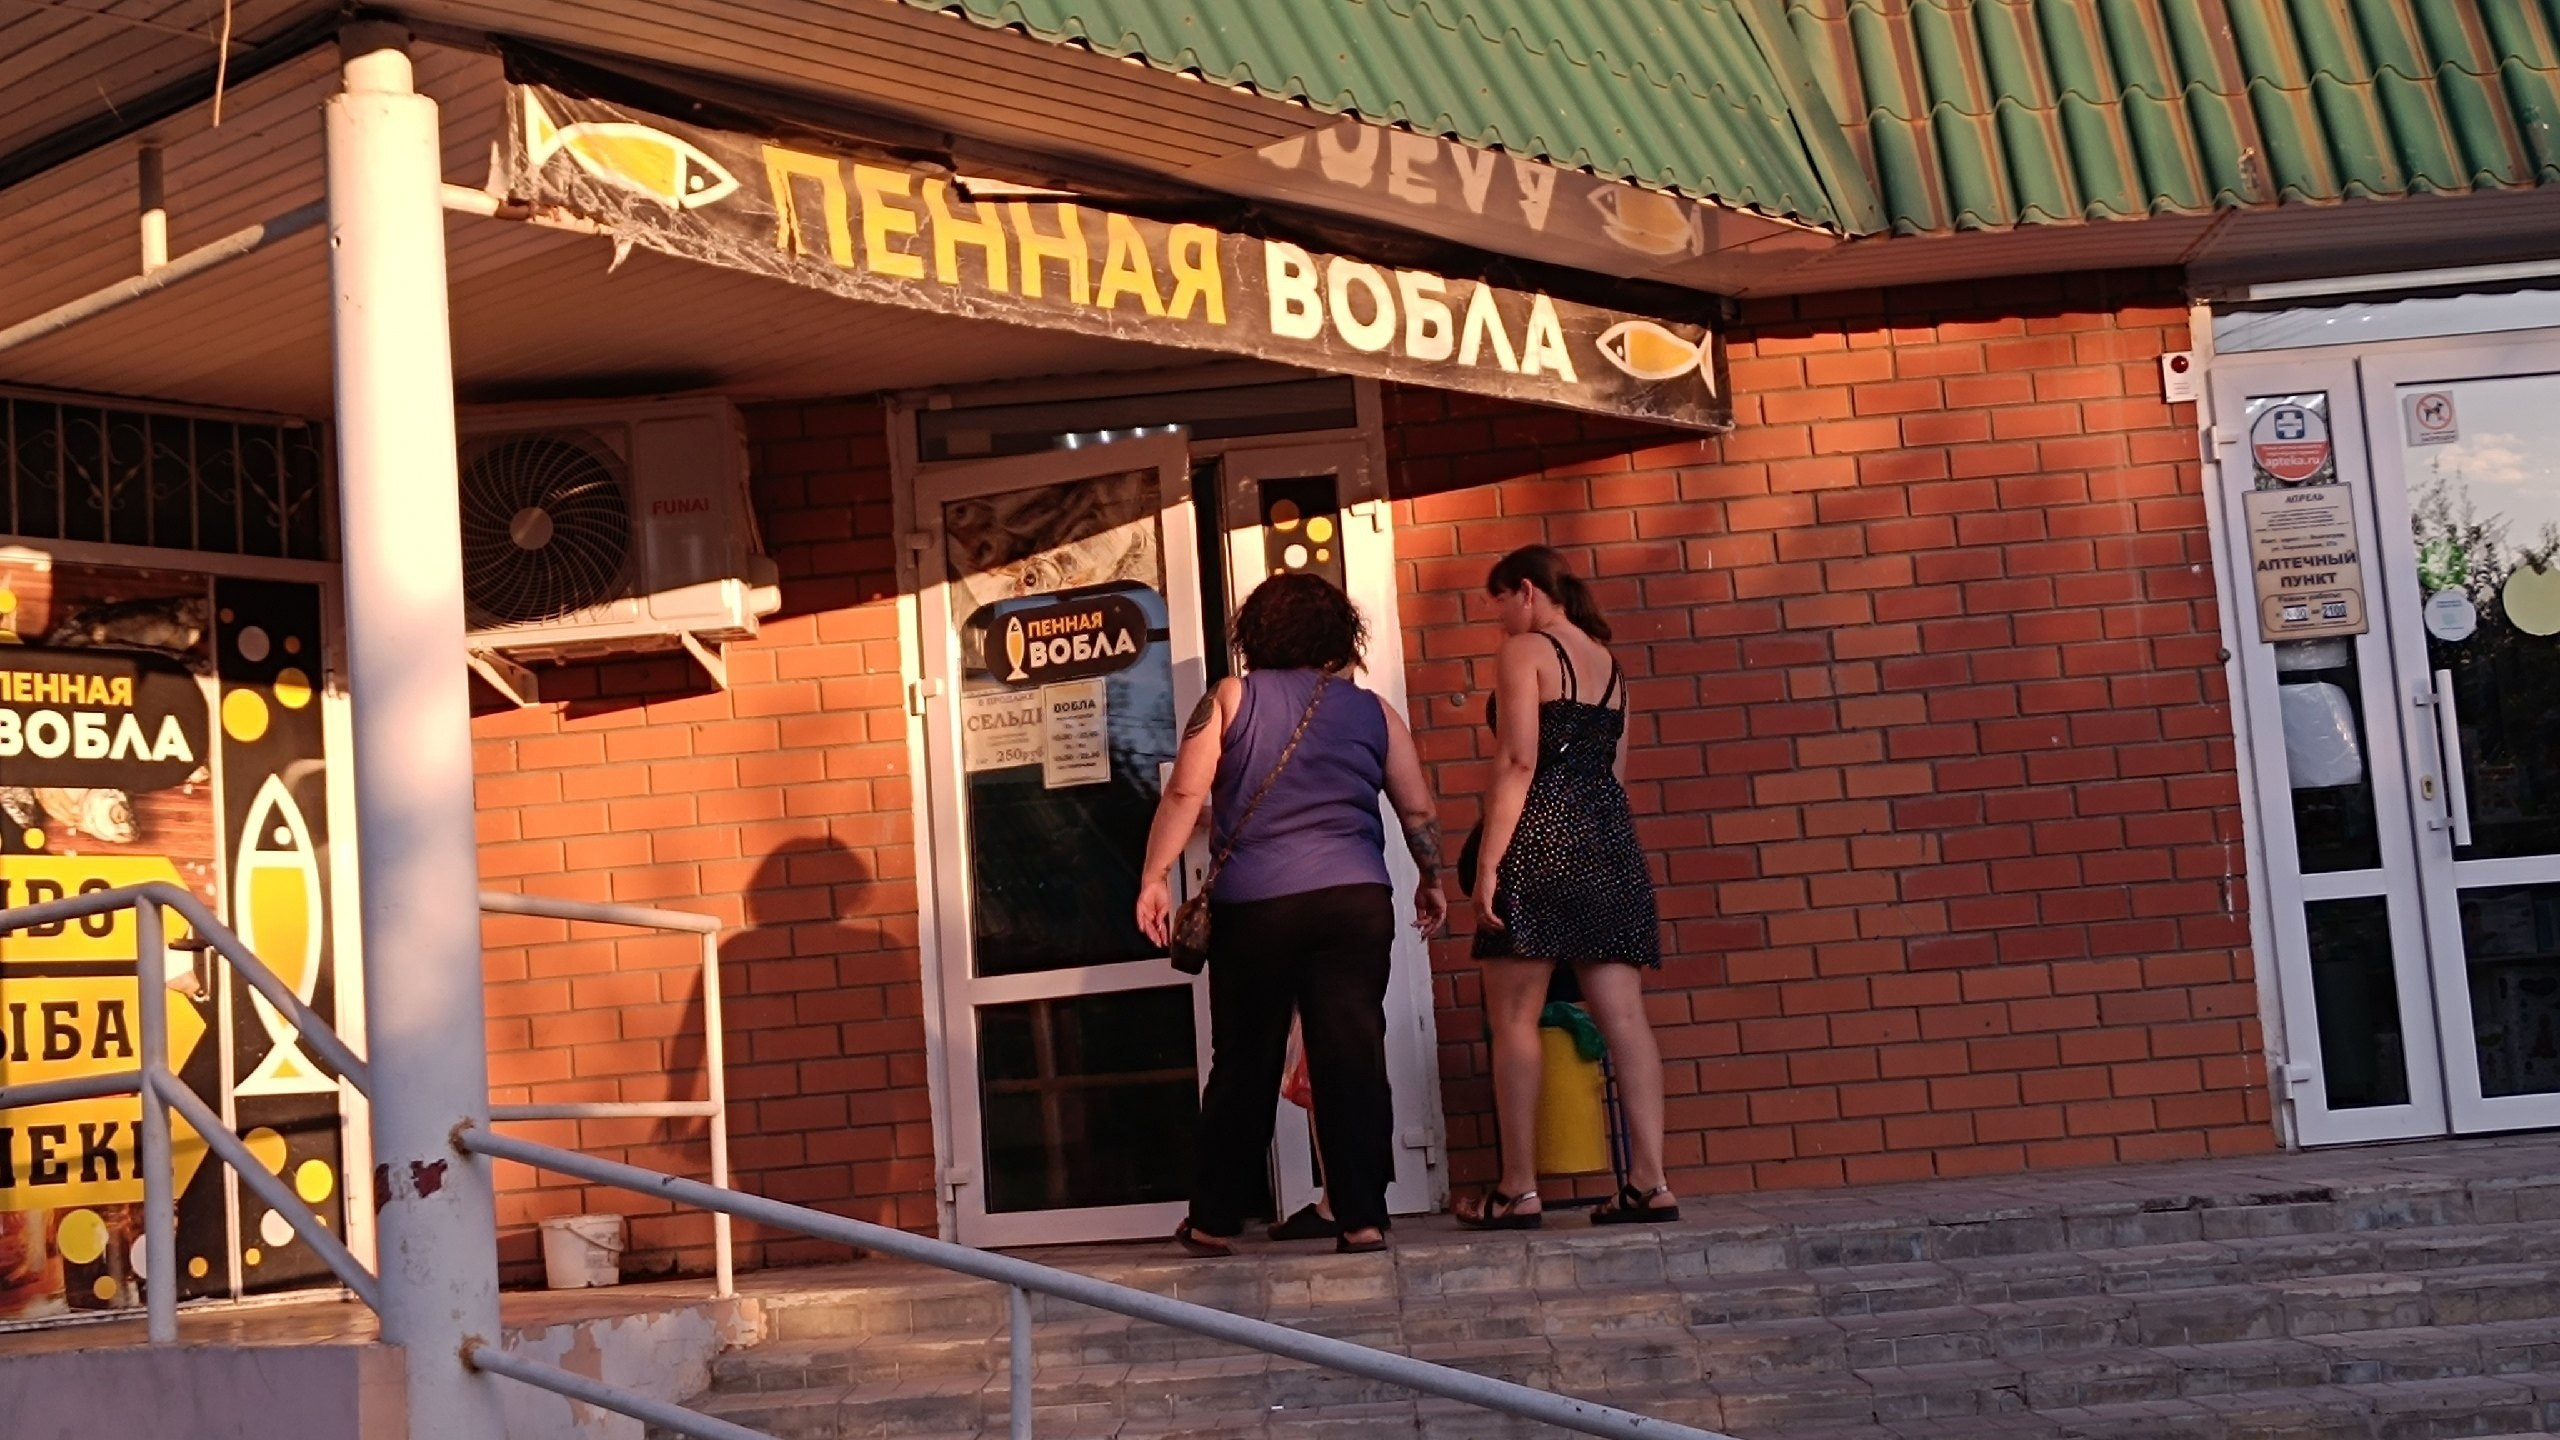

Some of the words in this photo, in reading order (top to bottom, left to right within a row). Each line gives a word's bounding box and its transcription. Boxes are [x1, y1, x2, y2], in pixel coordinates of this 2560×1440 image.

[762, 144, 1226, 325] ПЕННАЯ
[1264, 240, 1578, 384] ВОБЛА
[2265, 456, 2320, 469] apteka.ru
[652, 497, 709, 515] FUNAI
[2285, 493, 2325, 504] АПРЕЛЬ
[2257, 549, 2357, 572] АПТЕЧНЫЙ
[2280, 572, 2337, 589] ПУНКТ
[1028, 611, 1102, 638] ПЕННАЯ
[1029, 628, 1136, 669] ВОБЛА
[1053, 699, 1097, 713] ВОБЛА
[0, 708, 194, 762] ВОБЛА
